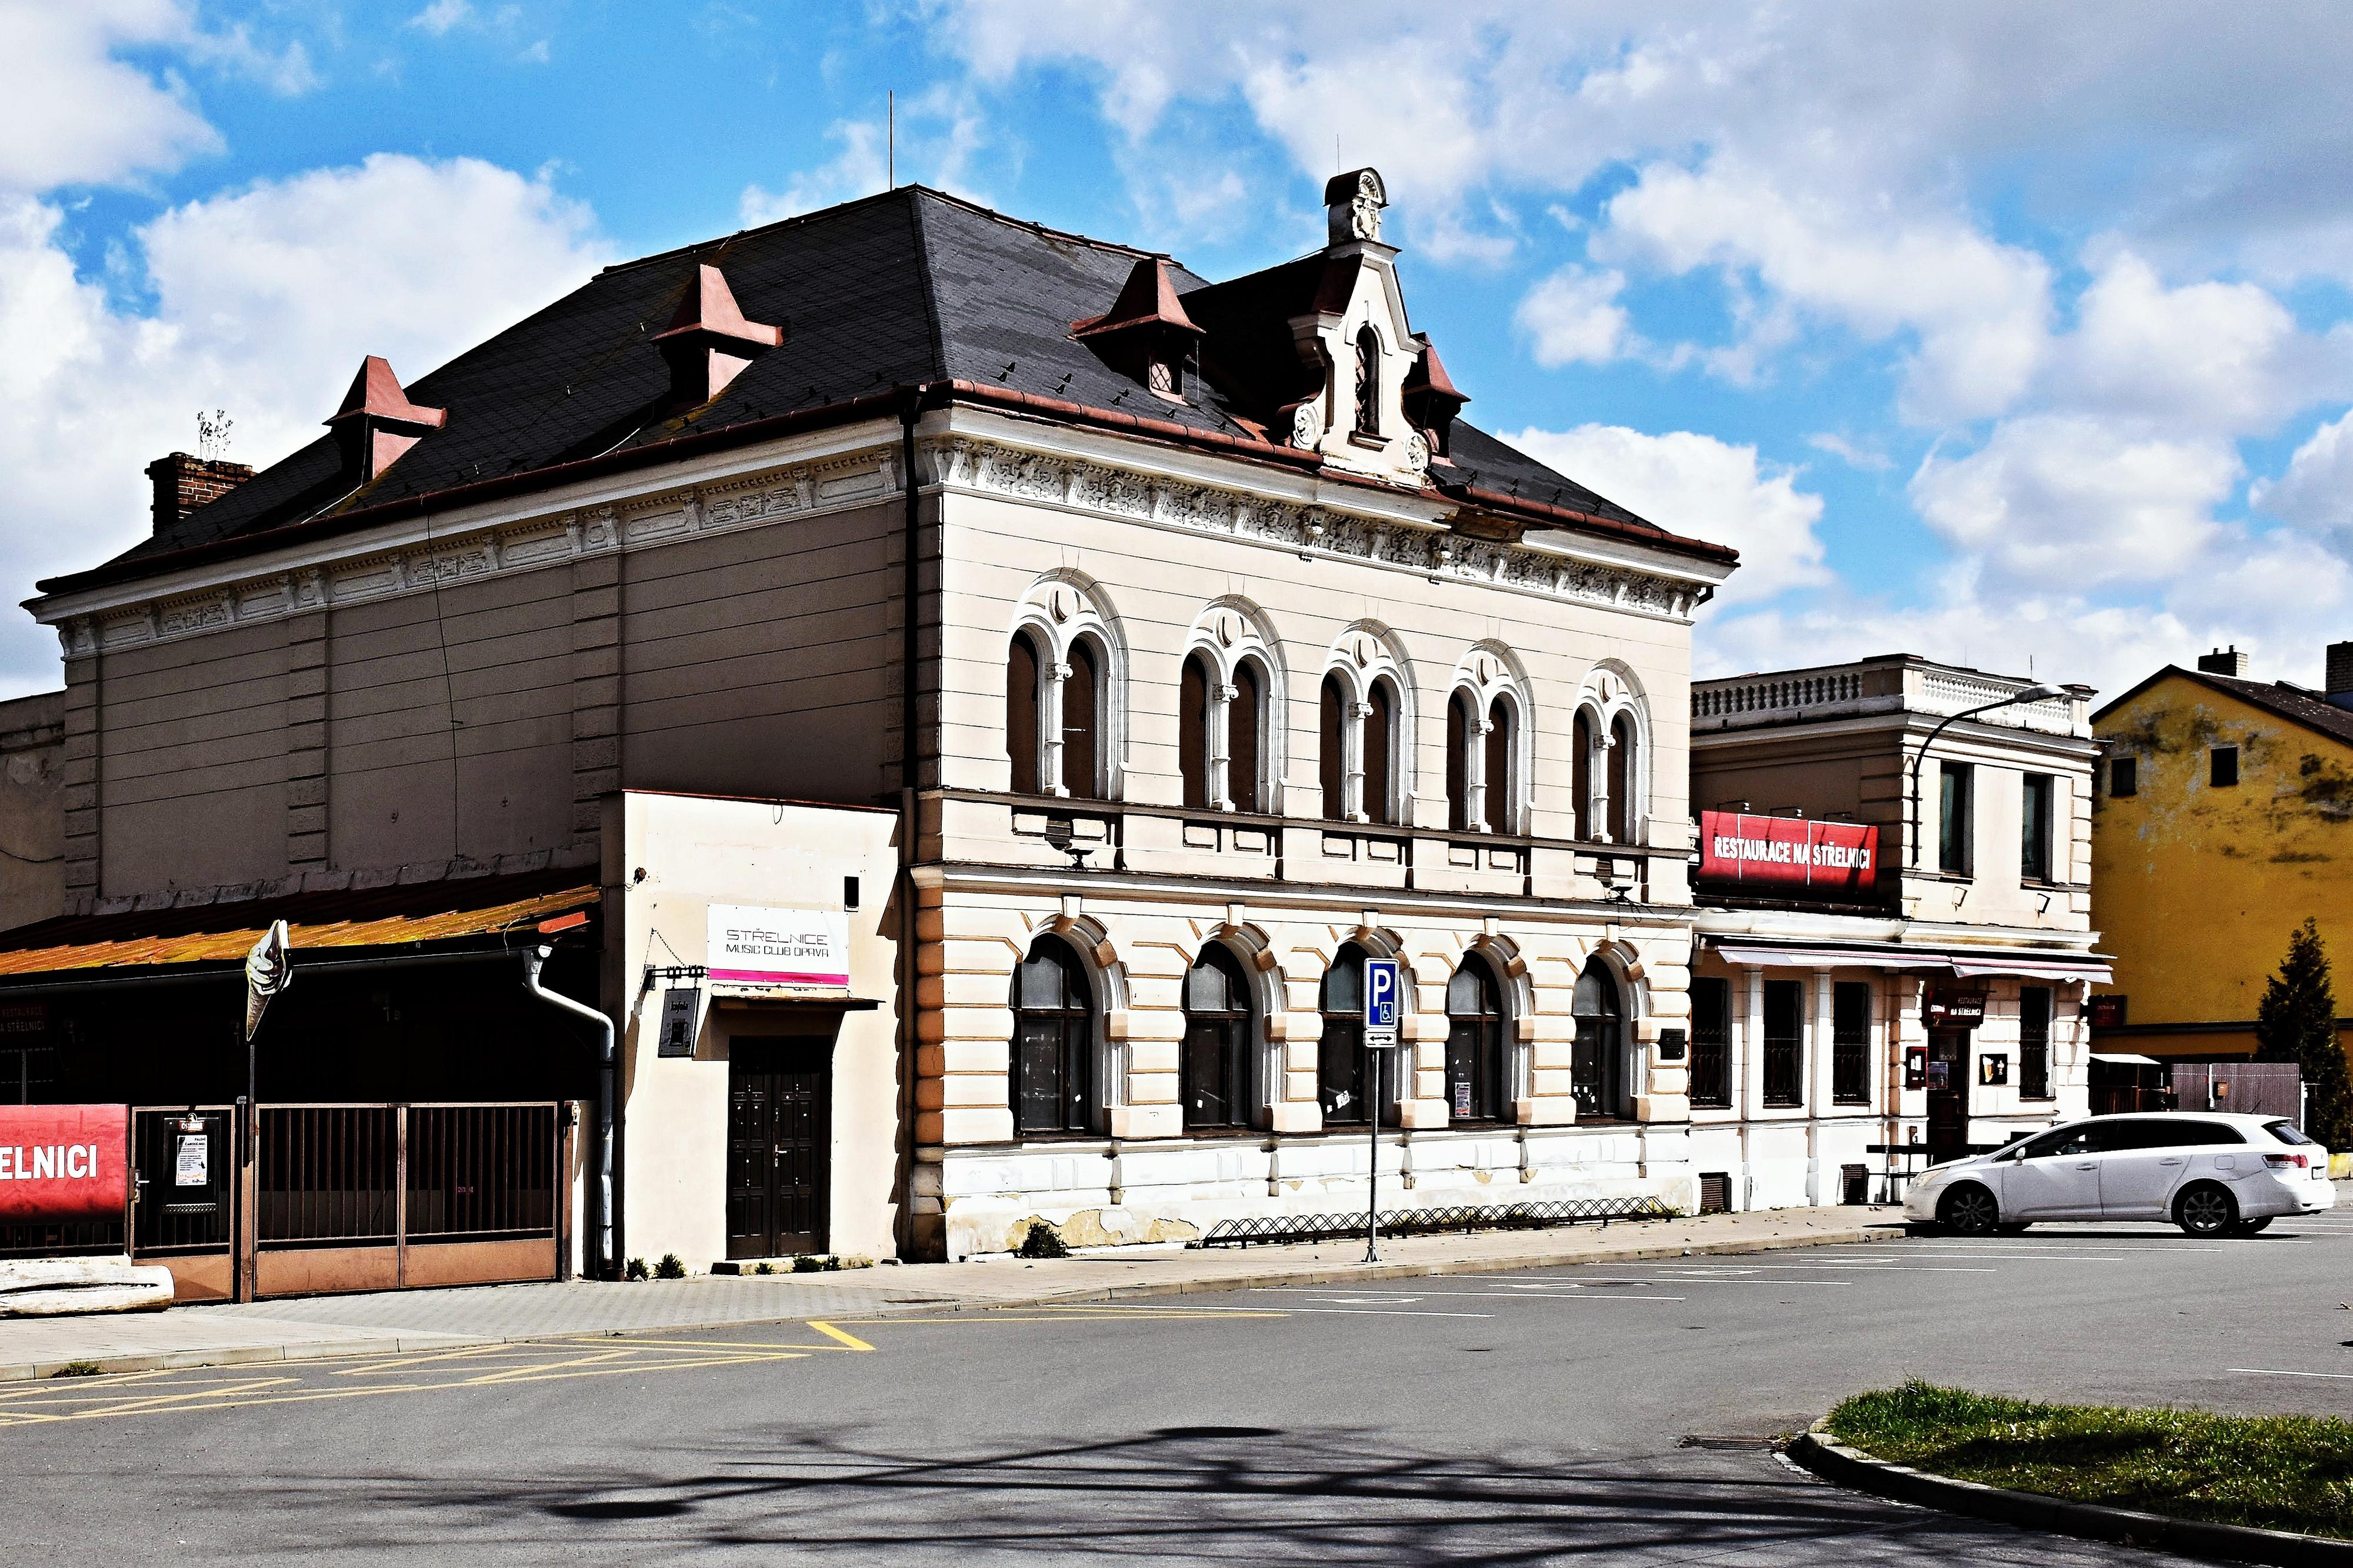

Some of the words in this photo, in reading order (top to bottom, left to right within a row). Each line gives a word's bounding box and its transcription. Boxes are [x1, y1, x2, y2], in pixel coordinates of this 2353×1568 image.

[1714, 837, 1790, 863] RESTAURACE
[1794, 843, 1809, 865] NA
[1812, 841, 1871, 869] STŘELNICI
[726, 928, 828, 946] STŘELNICE
[726, 943, 761, 955] MUSIC
[764, 945, 791, 956] CLUB
[794, 947, 829, 958] OPAVA
[1373, 969, 1391, 1007] P
[7, 1019, 45, 1033] STŘELNICI
